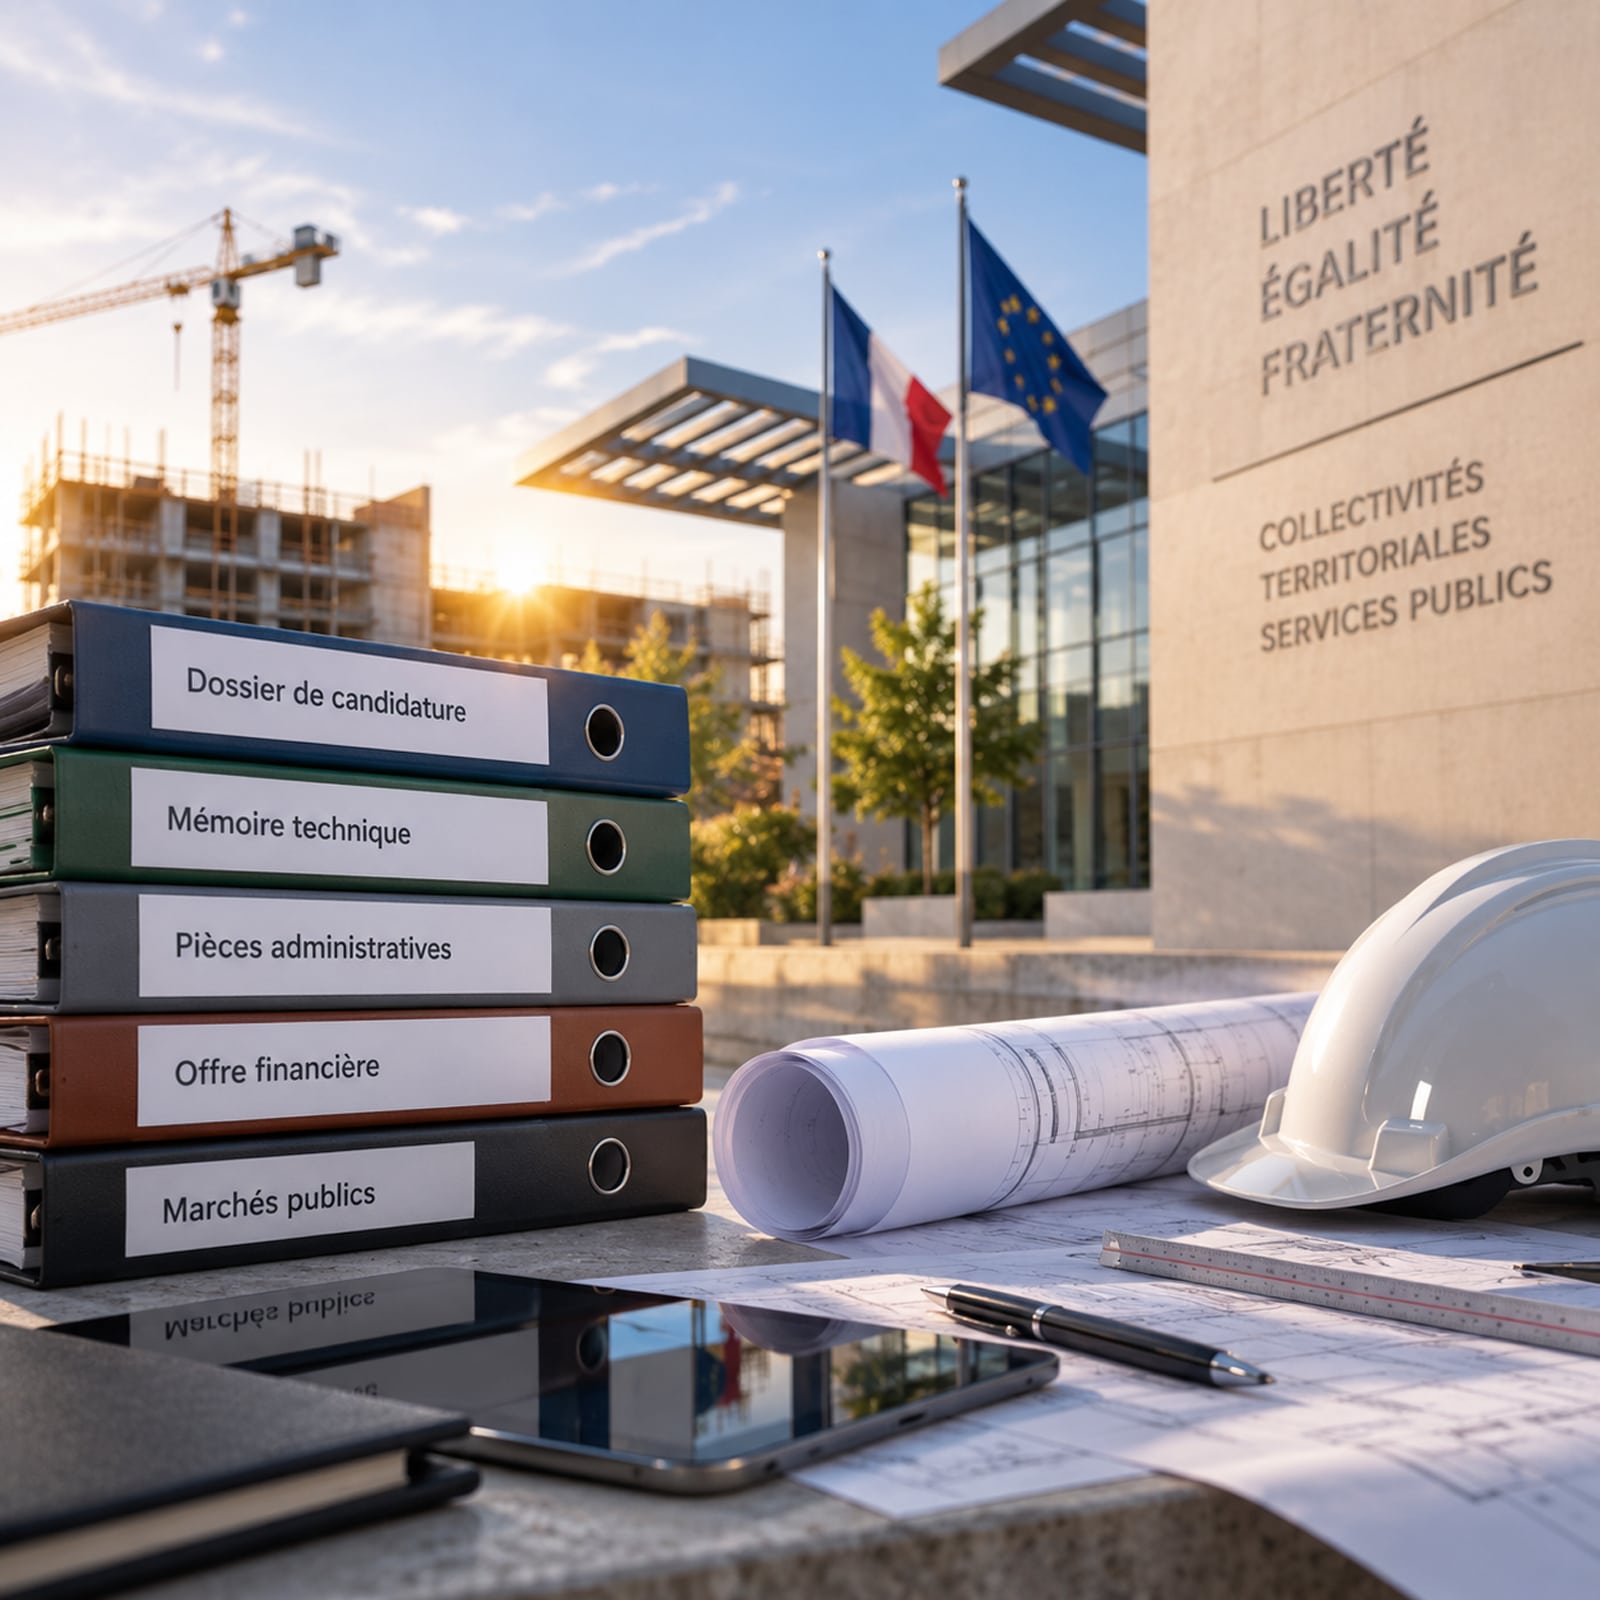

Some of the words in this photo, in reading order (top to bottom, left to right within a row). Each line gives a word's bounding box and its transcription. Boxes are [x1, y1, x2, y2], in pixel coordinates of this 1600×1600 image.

[1260, 115, 1430, 249] LIBERTÉ
[1260, 190, 1440, 323] ÉGALITÉ
[1261, 230, 1539, 397] FRATERNITÉ
[1259, 458, 1485, 552] COLLECTIVITÉS
[1260, 515, 1492, 601] TERRITORIALES
[1260, 595, 1398, 653] SERVICES
[1410, 559, 1554, 622] PUBLICS
[186, 666, 287, 703] Dossier
[293, 679, 326, 708] de
[331, 690, 467, 724] candidature
[167, 804, 286, 838] Mémoire
[291, 815, 412, 850] technique
[175, 931, 264, 960] Pièces
[270, 932, 453, 961] administratives
[174, 1057, 248, 1087] Offre
[254, 1052, 381, 1083] financière
[163, 1188, 279, 1225] Marchés
[287, 1181, 376, 1219] publics
